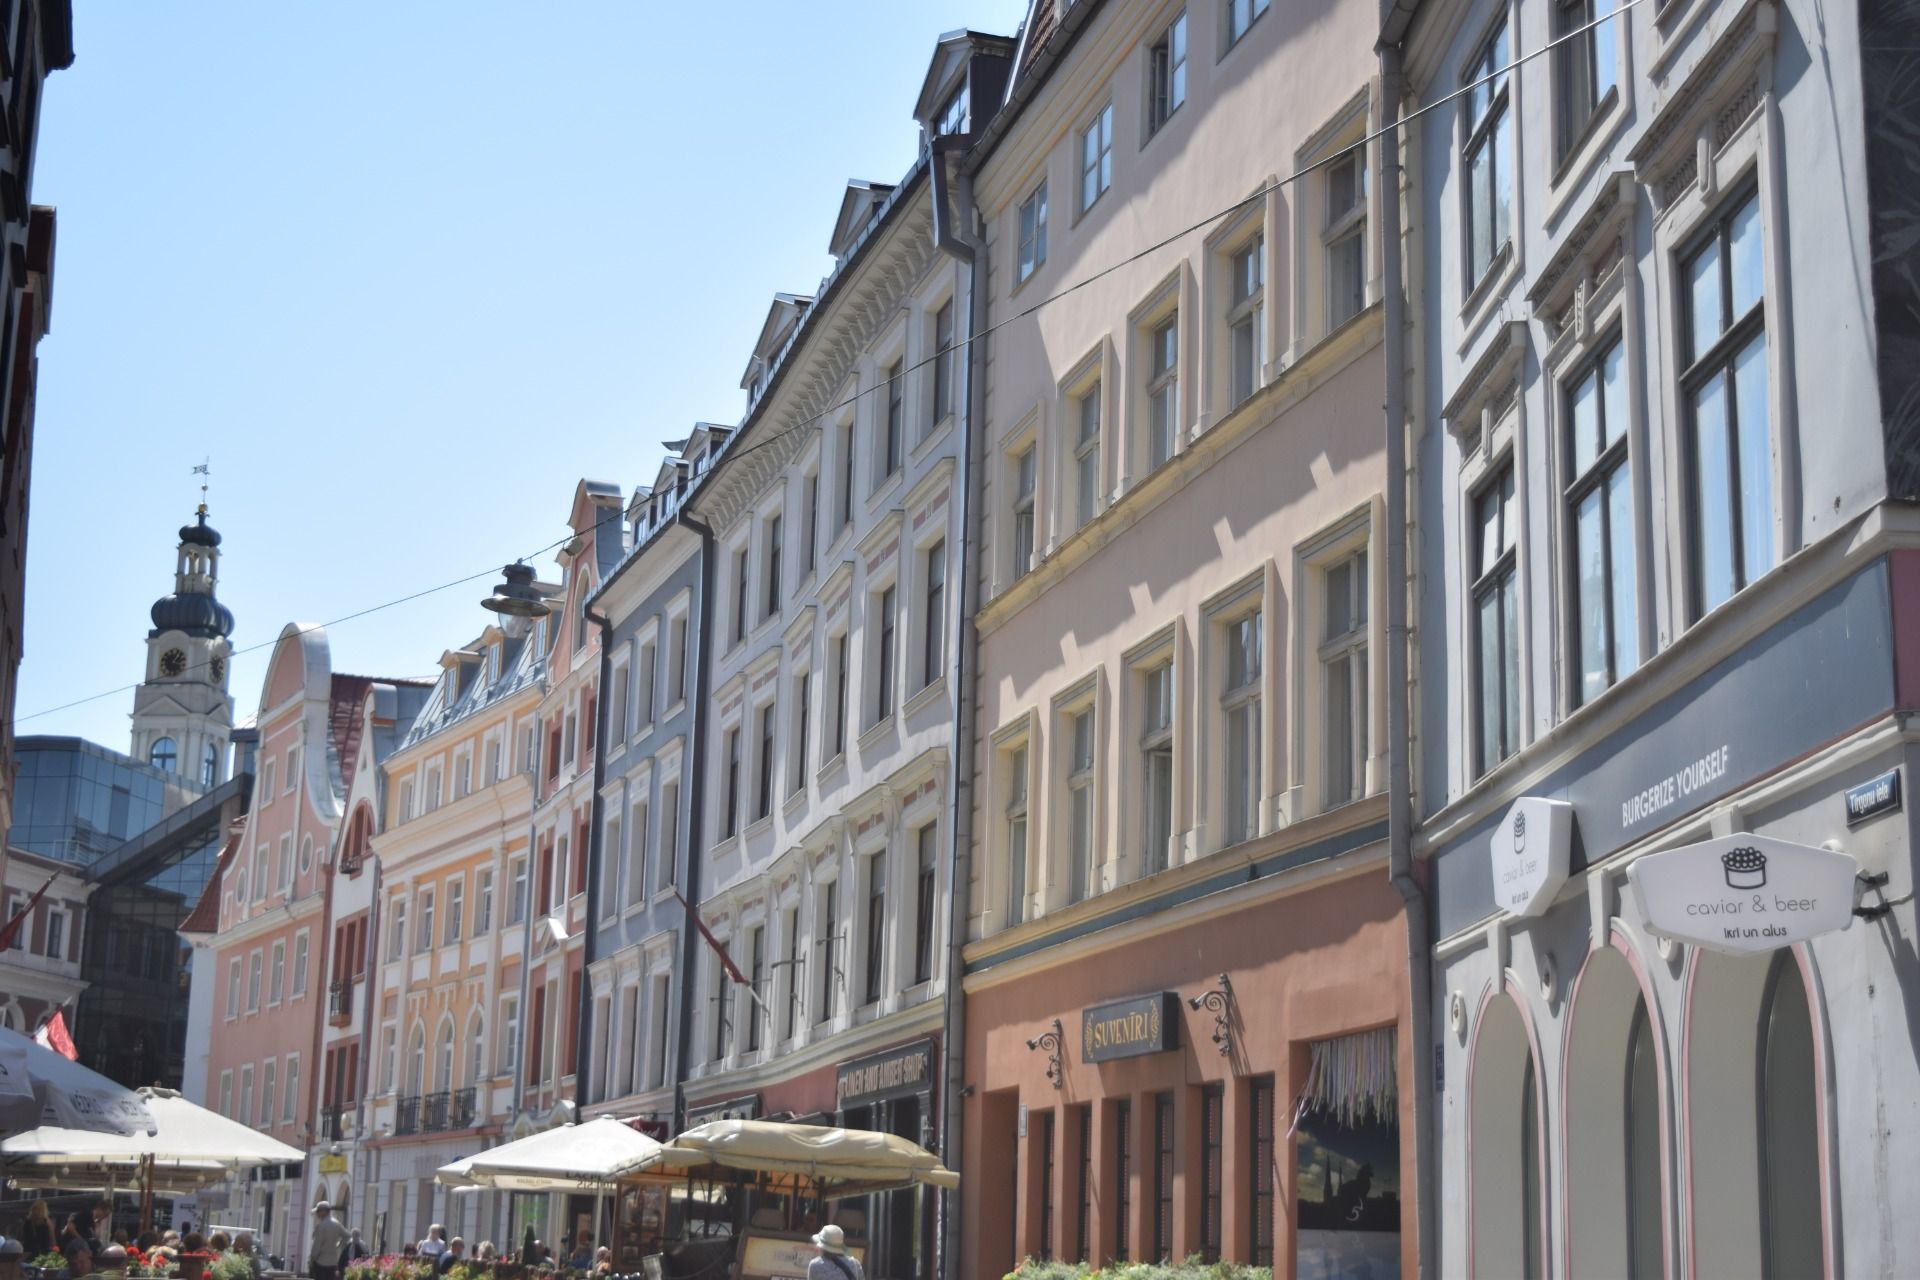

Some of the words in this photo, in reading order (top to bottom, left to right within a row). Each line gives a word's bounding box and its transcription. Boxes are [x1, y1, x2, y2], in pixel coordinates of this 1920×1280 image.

[1622, 776, 1674, 828] BURGERIZE
[1676, 744, 1728, 798] YOURSELF
[1876, 781, 1889, 803] iela
[1686, 899, 1743, 916] caviar
[1752, 894, 1767, 912] &
[1774, 894, 1817, 912] beer
[1743, 928, 1758, 938] un
[1762, 923, 1788, 937] alus
[1095, 1011, 1148, 1048] SUVENĪRI
[879, 1058, 903, 1089] AMBER
